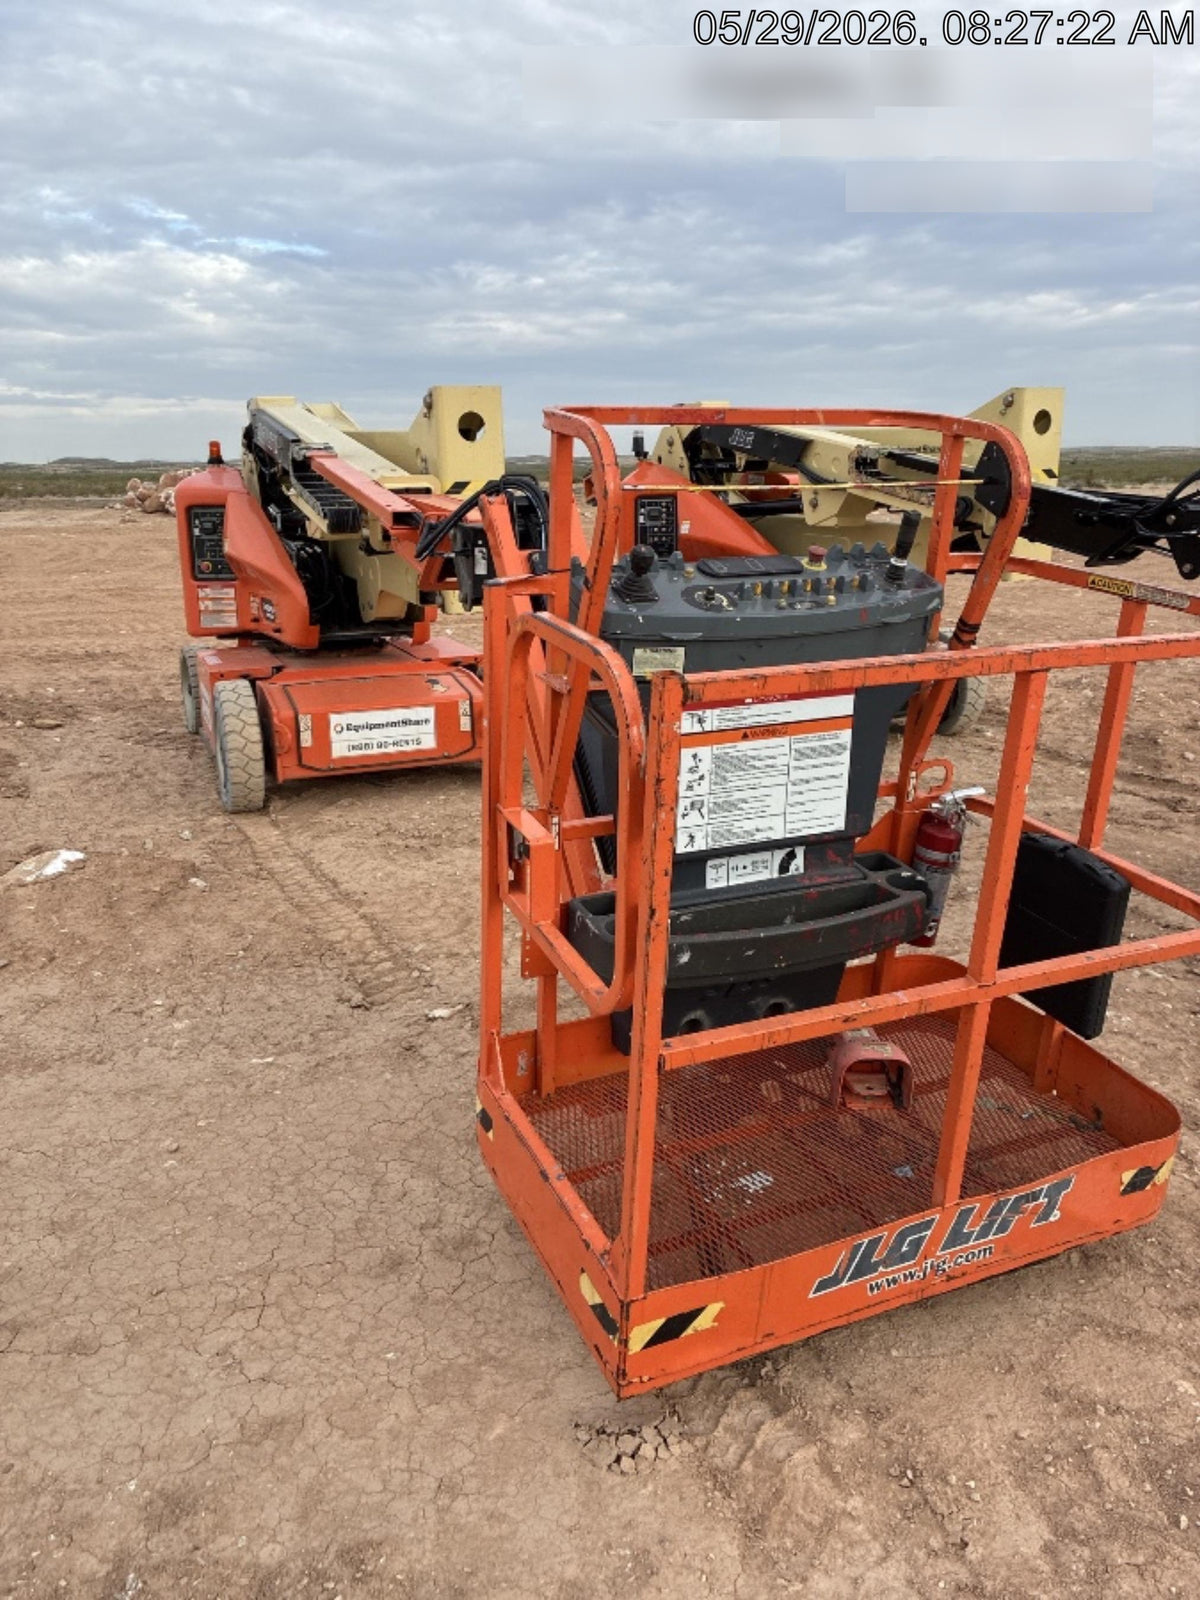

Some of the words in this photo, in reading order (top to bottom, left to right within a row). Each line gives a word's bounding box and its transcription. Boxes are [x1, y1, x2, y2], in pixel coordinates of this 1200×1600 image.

[346, 717, 431, 733] EquipmentShare
[807, 1213, 940, 1299] JLG
[936, 1173, 1077, 1255] LIFT
[866, 1243, 995, 1297] www.jlg.com
